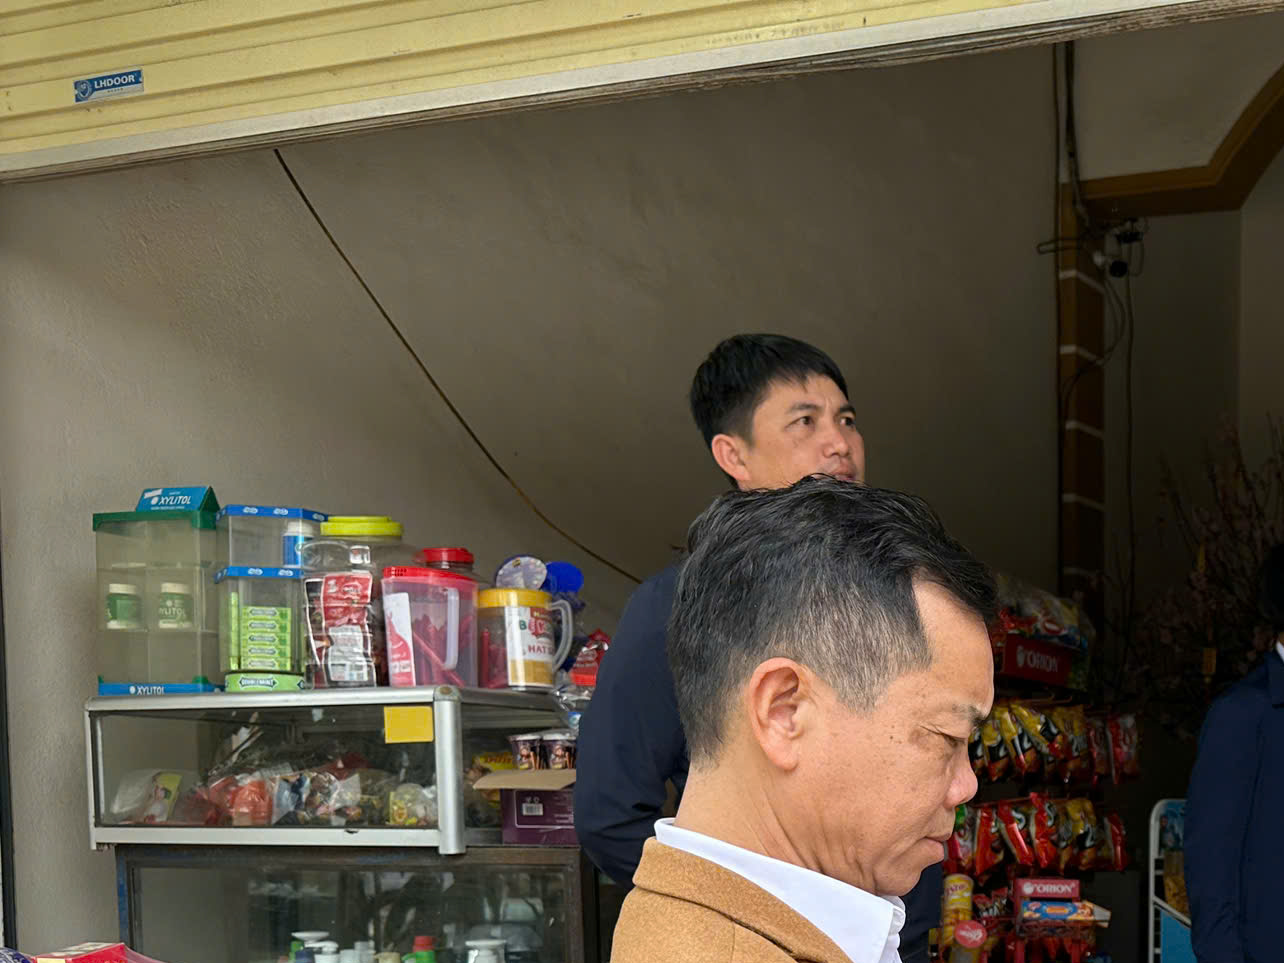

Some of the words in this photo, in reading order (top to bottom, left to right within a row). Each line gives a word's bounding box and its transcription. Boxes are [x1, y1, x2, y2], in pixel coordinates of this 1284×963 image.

[94, 75, 135, 89] LHDOOR
[158, 496, 192, 505] XYLITOL
[136, 685, 165, 695] XYLITOL
[1036, 882, 1073, 895] ORION
